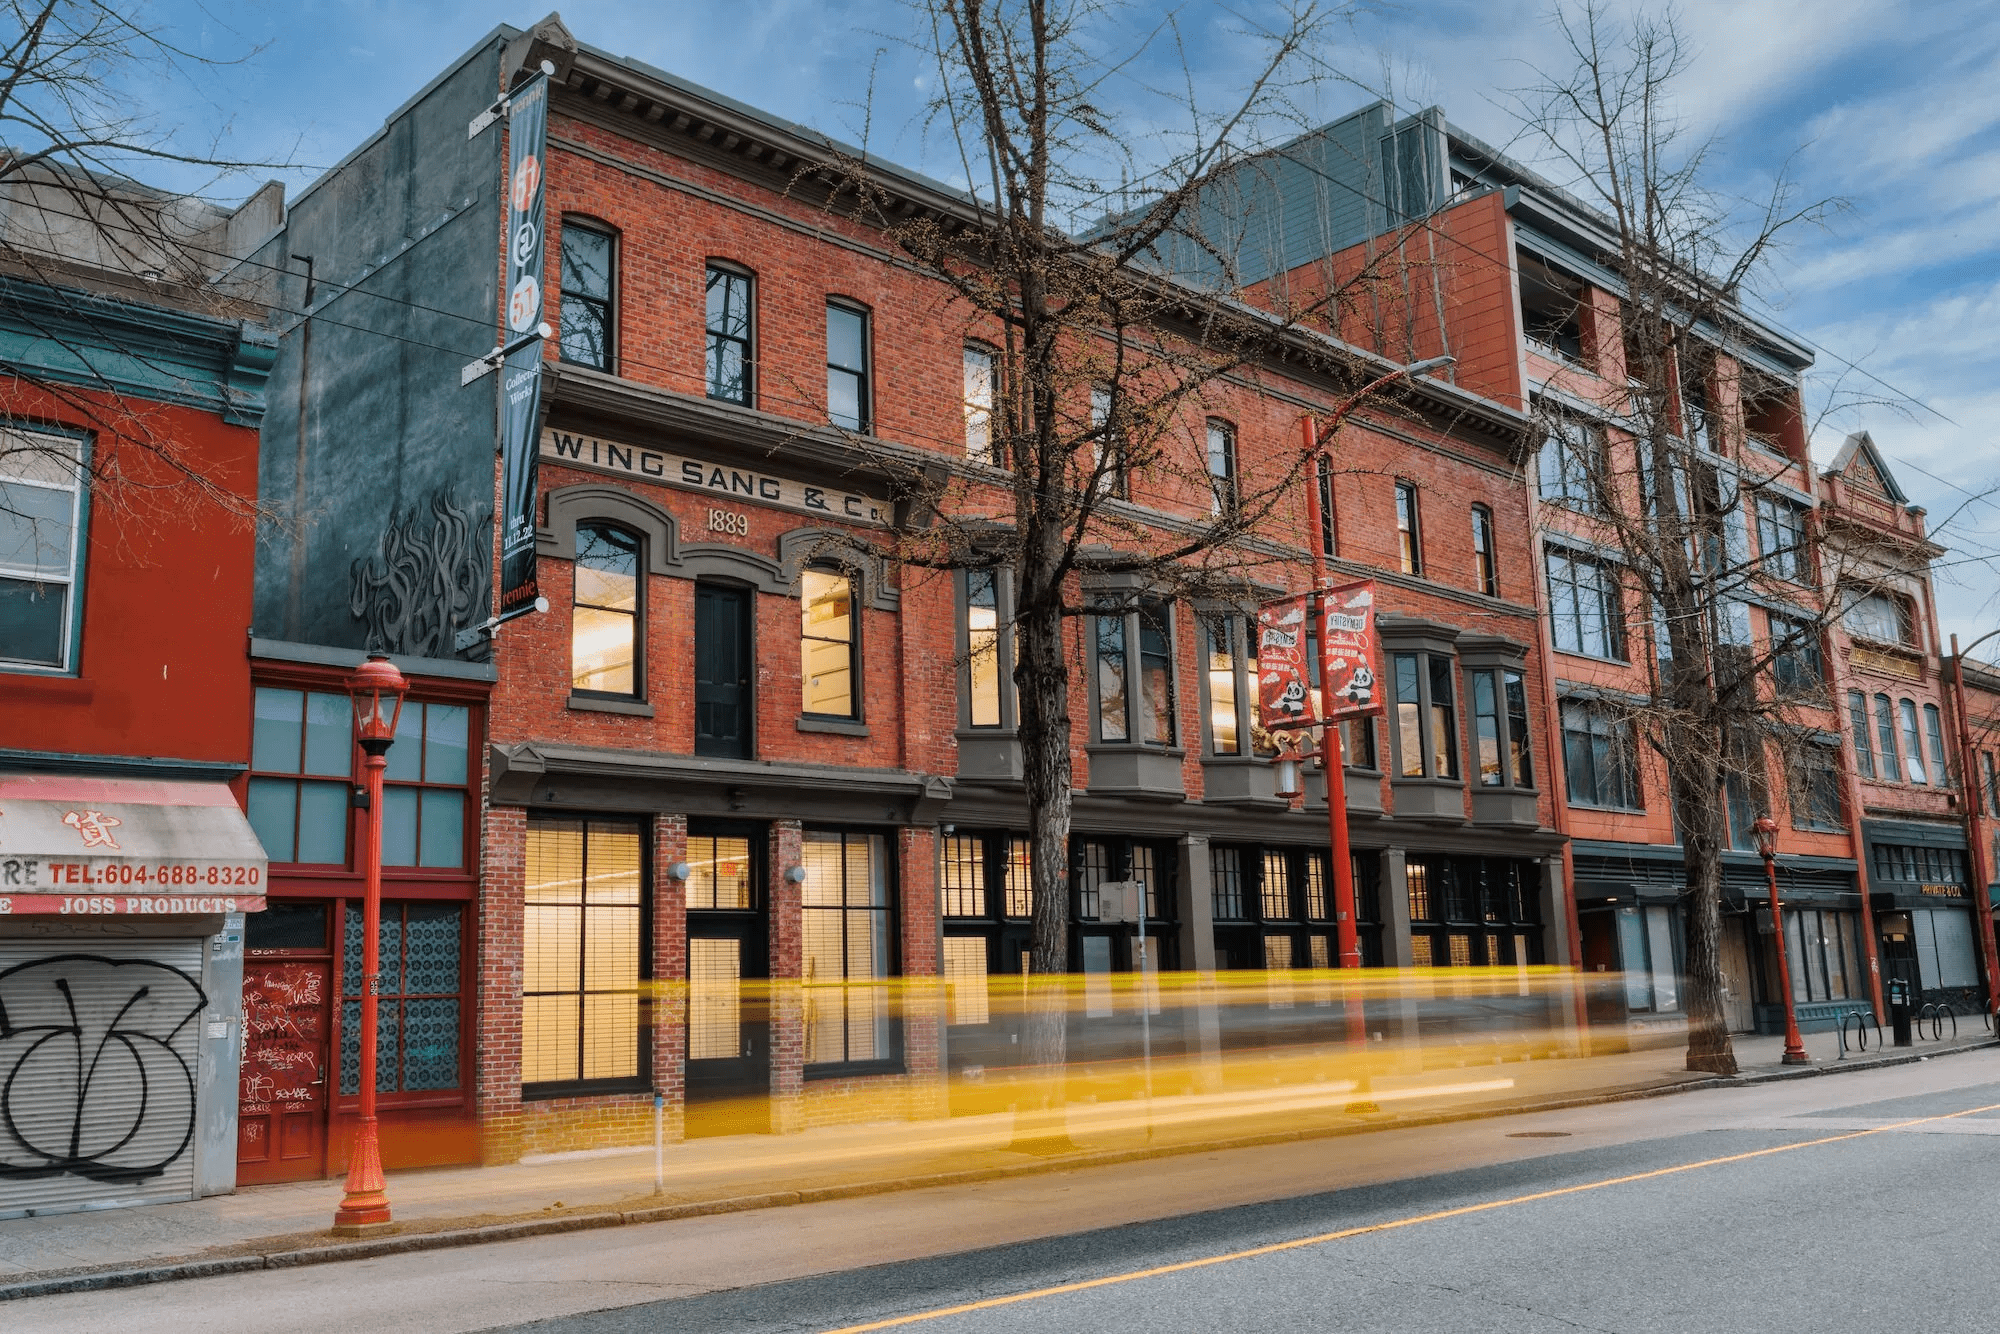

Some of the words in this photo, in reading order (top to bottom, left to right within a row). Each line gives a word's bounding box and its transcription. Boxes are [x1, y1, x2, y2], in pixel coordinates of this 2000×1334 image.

[505, 362, 540, 391] Collected
[510, 385, 534, 405] Works
[552, 431, 664, 476] WING
[682, 461, 780, 500] SANG
[804, 487, 832, 511] &
[510, 514, 526, 530] thru
[708, 508, 748, 536] 1889
[504, 524, 534, 550] 11.12.22
[501, 580, 536, 608] rennie
[2, 860, 39, 886] RE
[48, 863, 260, 885] TEL:604-688-8320
[59, 897, 116, 914] JOSS
[126, 898, 238, 914] PRODUCTS
